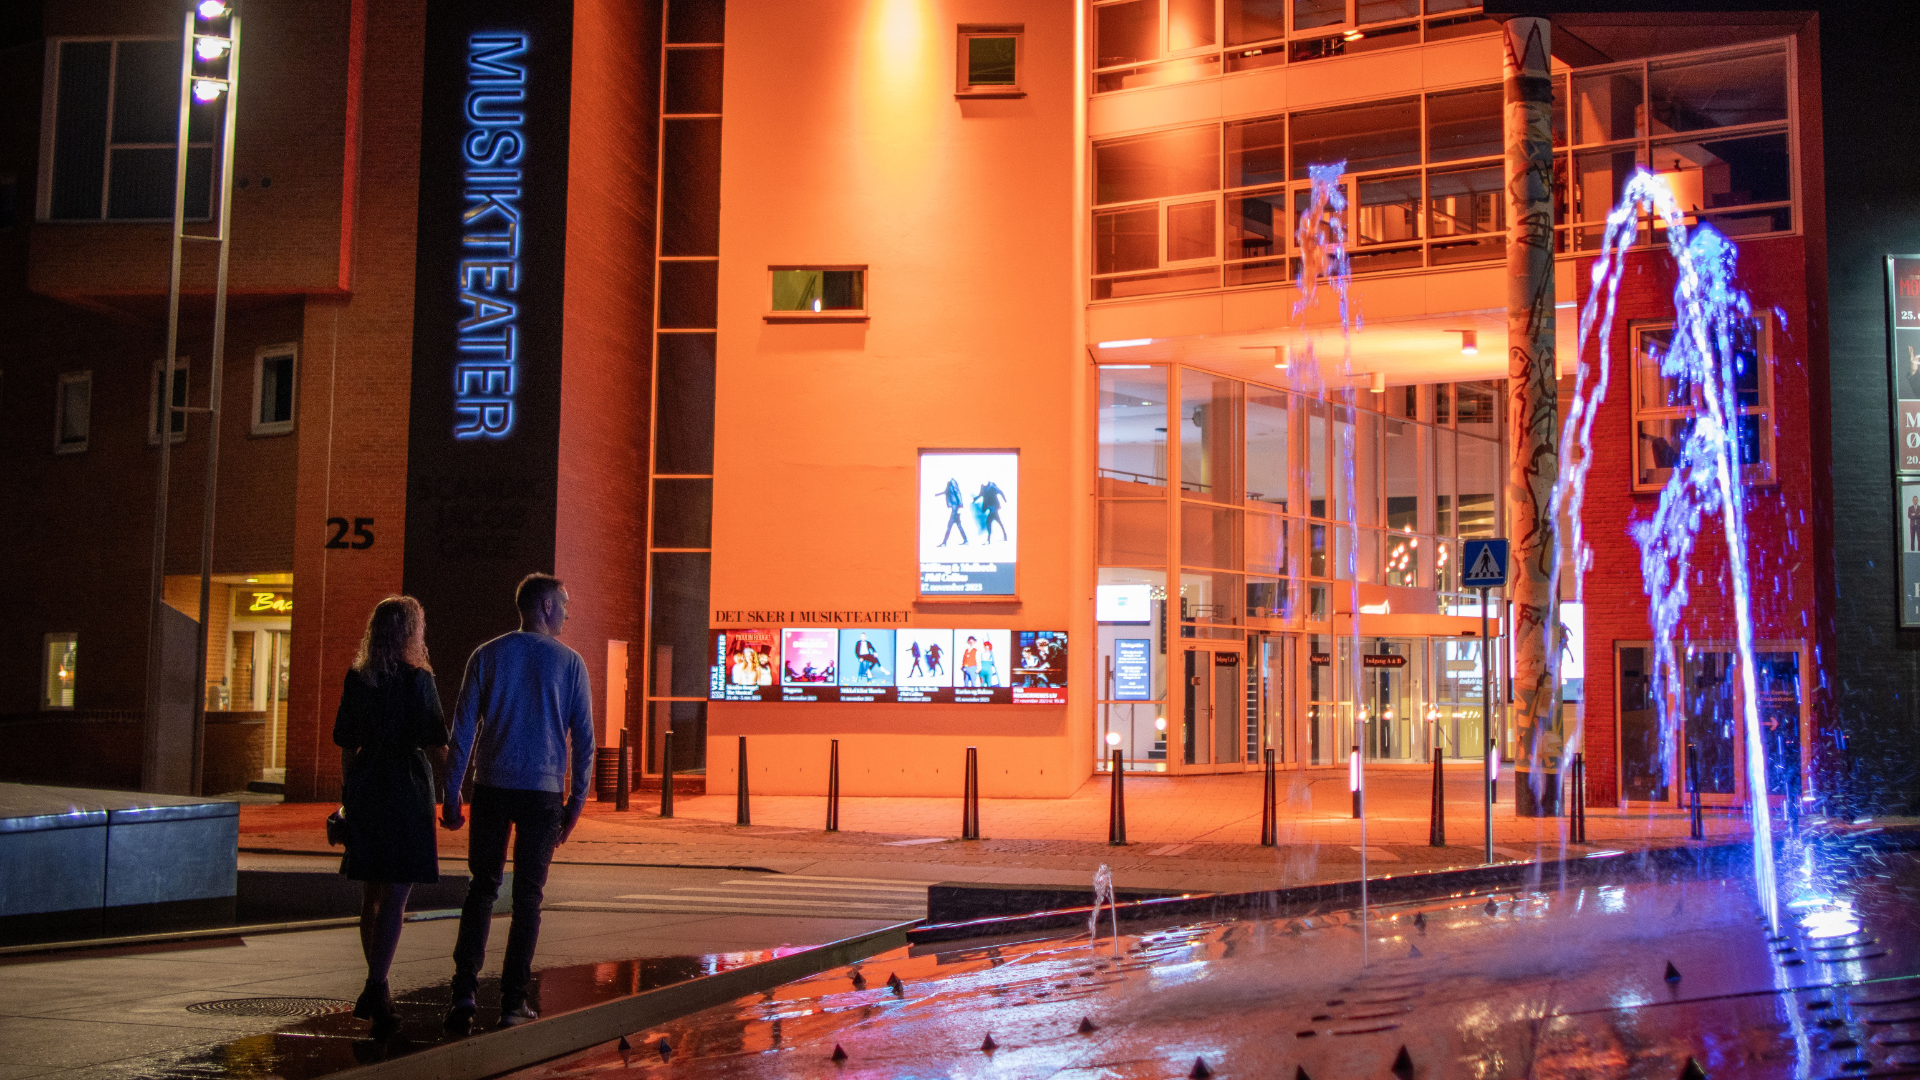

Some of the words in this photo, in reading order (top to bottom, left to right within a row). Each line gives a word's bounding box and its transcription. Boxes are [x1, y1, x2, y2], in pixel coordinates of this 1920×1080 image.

[455, 34, 524, 438] MUSIKTEATER
[1901, 310, 1916, 320] 25.
[324, 517, 375, 550] 25
[930, 583, 964, 592] november
[716, 610, 744, 623] DET
[747, 610, 785, 623] SKER
[790, 610, 795, 623] I
[799, 610, 911, 623] MUSIKTEATRET
[1366, 657, 1387, 665] Indgang
[711, 665, 719, 691] VEJLE
